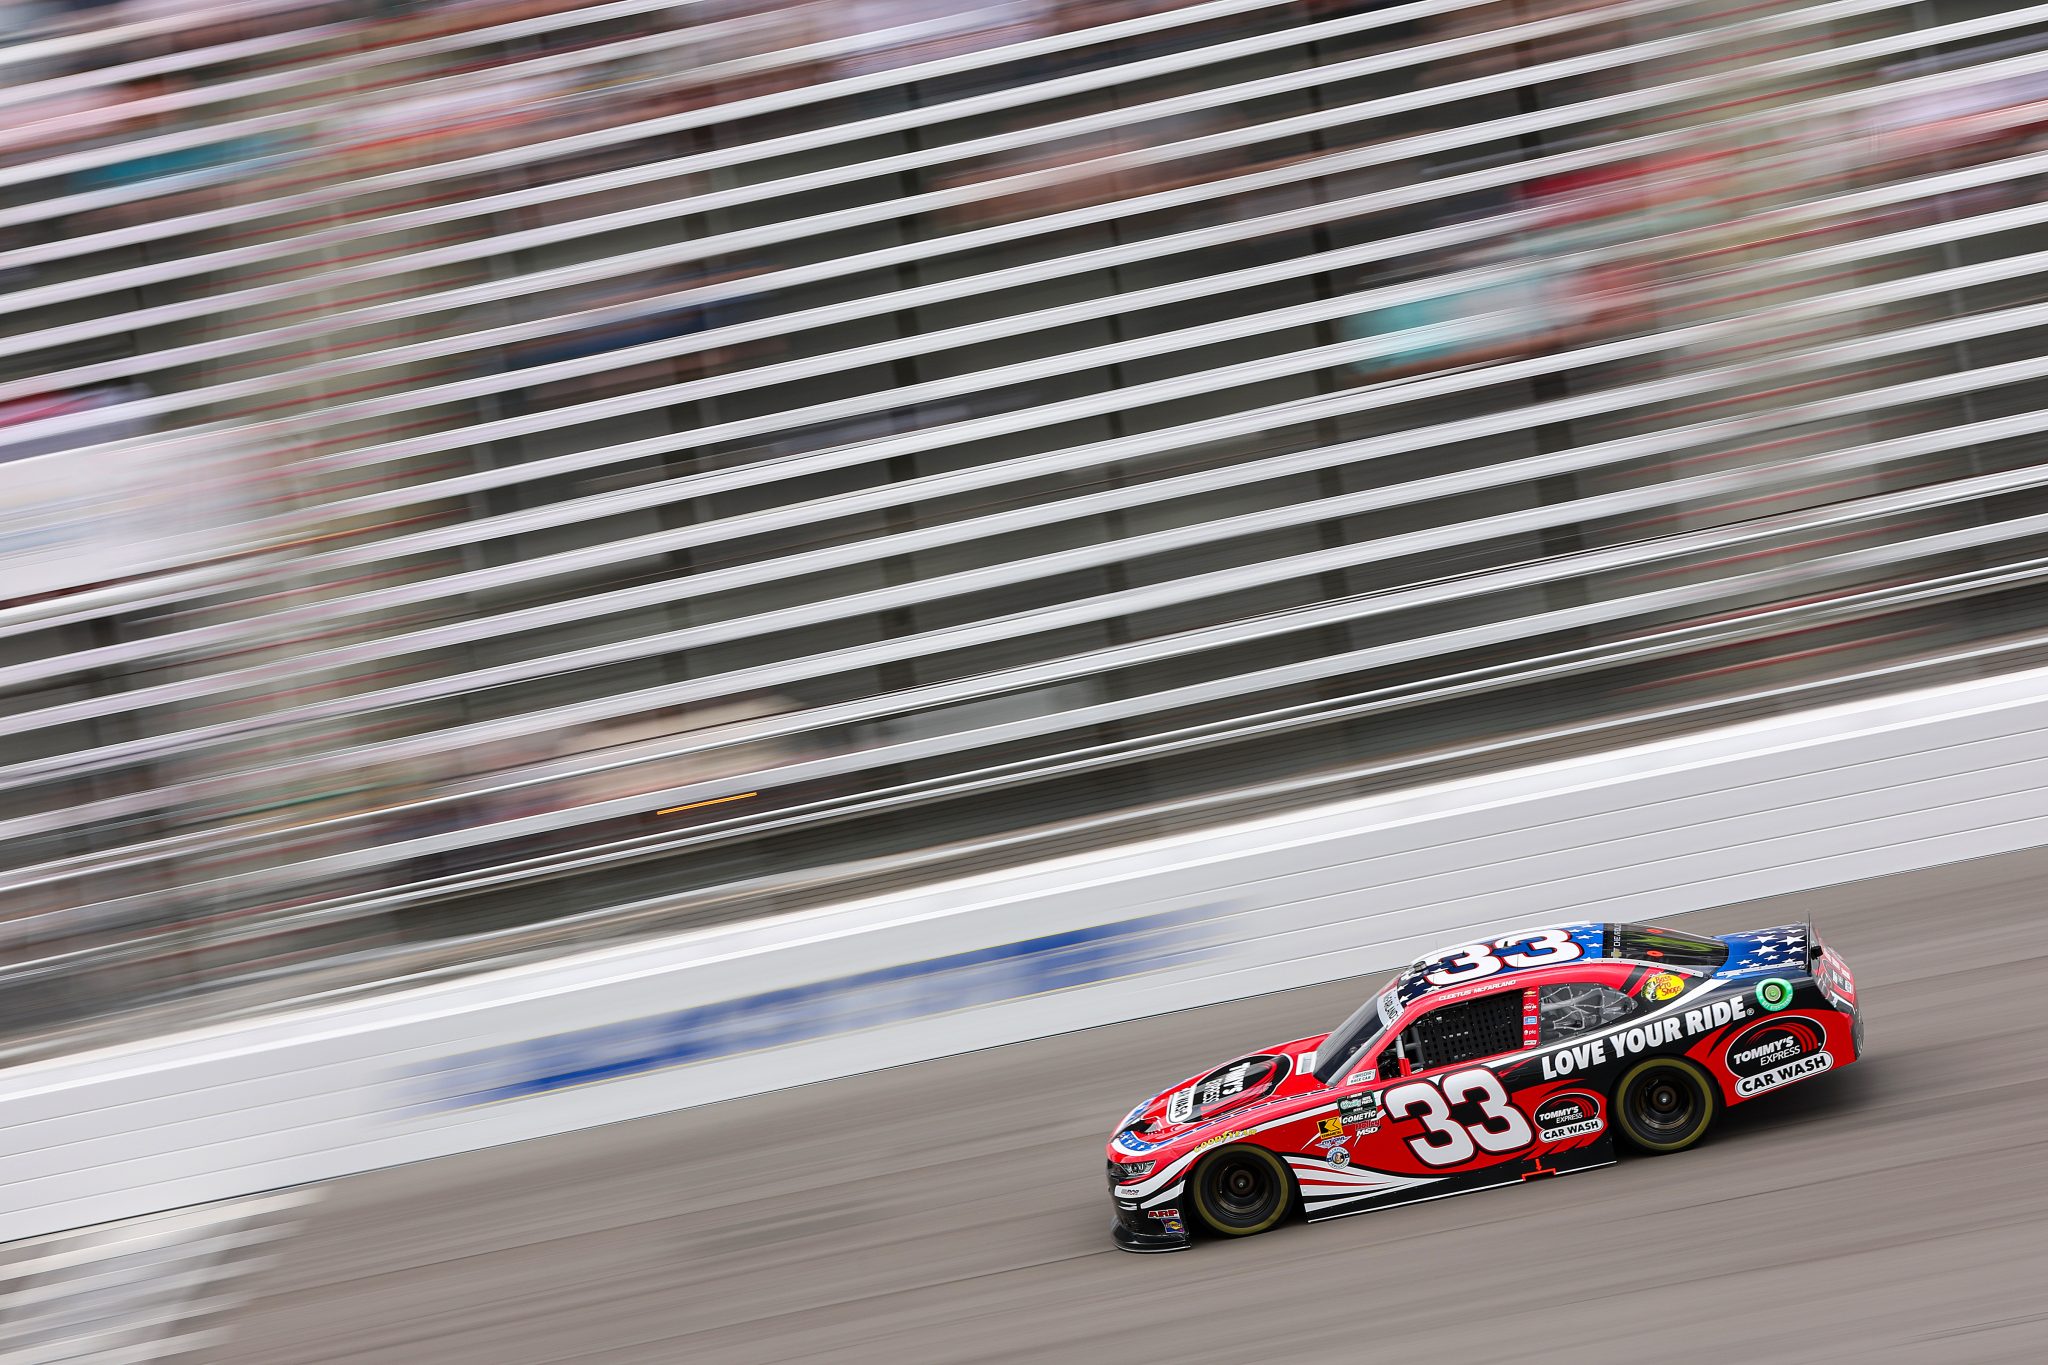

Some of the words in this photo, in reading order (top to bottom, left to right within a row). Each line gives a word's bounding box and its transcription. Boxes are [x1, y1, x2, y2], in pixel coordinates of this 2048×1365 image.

[1423, 928, 1583, 985] 33
[1541, 1041, 1606, 1080] LOVE
[1609, 1017, 1683, 1059] YOUR
[1733, 1035, 1794, 1065] TOMMY'S
[1760, 1045, 1801, 1066] EXPRESS
[1742, 1073, 1775, 1092] CAR
[1777, 1055, 1826, 1080] WASH
[1342, 1110, 1377, 1124] COMETIC
[1384, 1068, 1533, 1166] 33
[1539, 1105, 1579, 1121] TOMMY'S
[1556, 1111, 1583, 1124] EXPRESS
[1193, 1128, 1257, 1153] GOODYEAR
[1356, 1126, 1378, 1137] MSD
[1543, 1128, 1565, 1140] CAR
[1567, 1121, 1599, 1134] WASH
[1148, 1209, 1178, 1218] ARP
